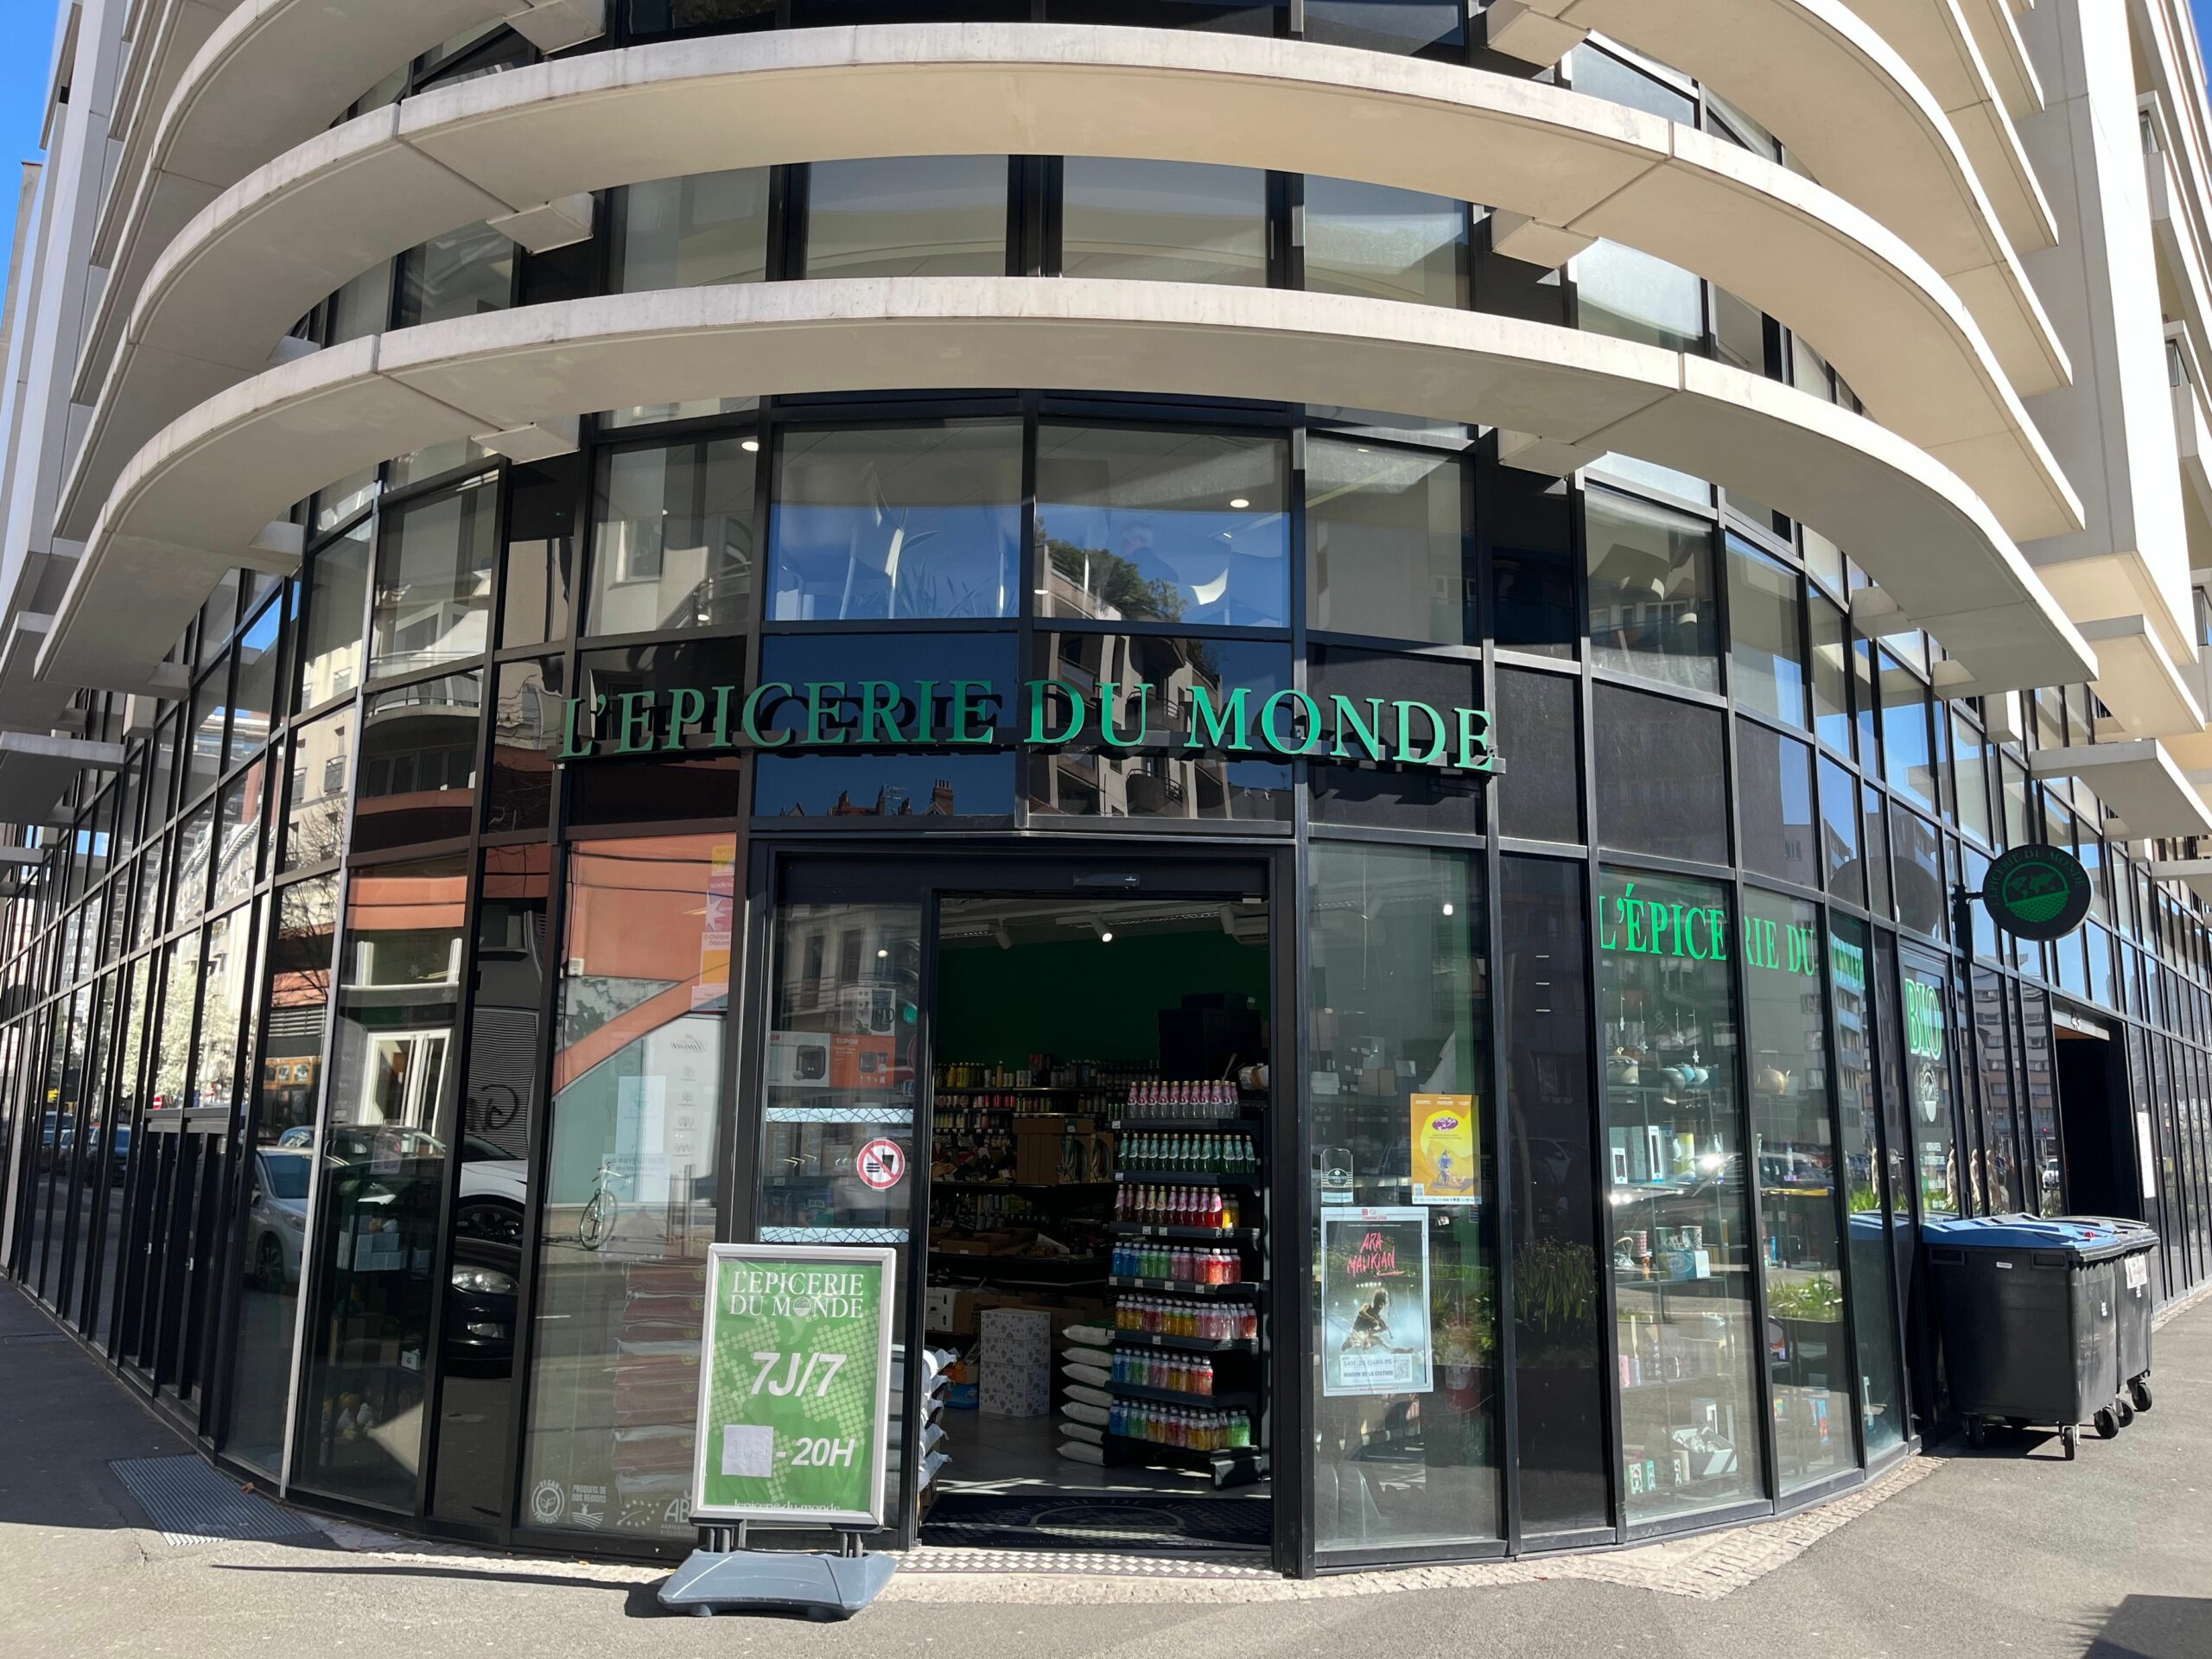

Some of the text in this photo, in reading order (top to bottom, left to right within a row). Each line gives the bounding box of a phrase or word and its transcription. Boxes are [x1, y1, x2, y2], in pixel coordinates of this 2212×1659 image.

[557, 680, 1493, 771] L'EPICERIE DU MONDE
[1788, 924, 1815, 977] DU
[1905, 977, 1942, 1060] BIO
[1360, 1231, 1383, 1253] ARA
[1347, 1244, 1395, 1278] MALIKIAN
[734, 1271, 864, 1296] L'EPICERIE
[729, 1295, 763, 1316] DU
[750, 1352, 847, 1396] 7J/7
[791, 1438, 855, 1466] 20H
[539, 1479, 560, 1490] VEGAN
[664, 1498, 690, 1522] AB
